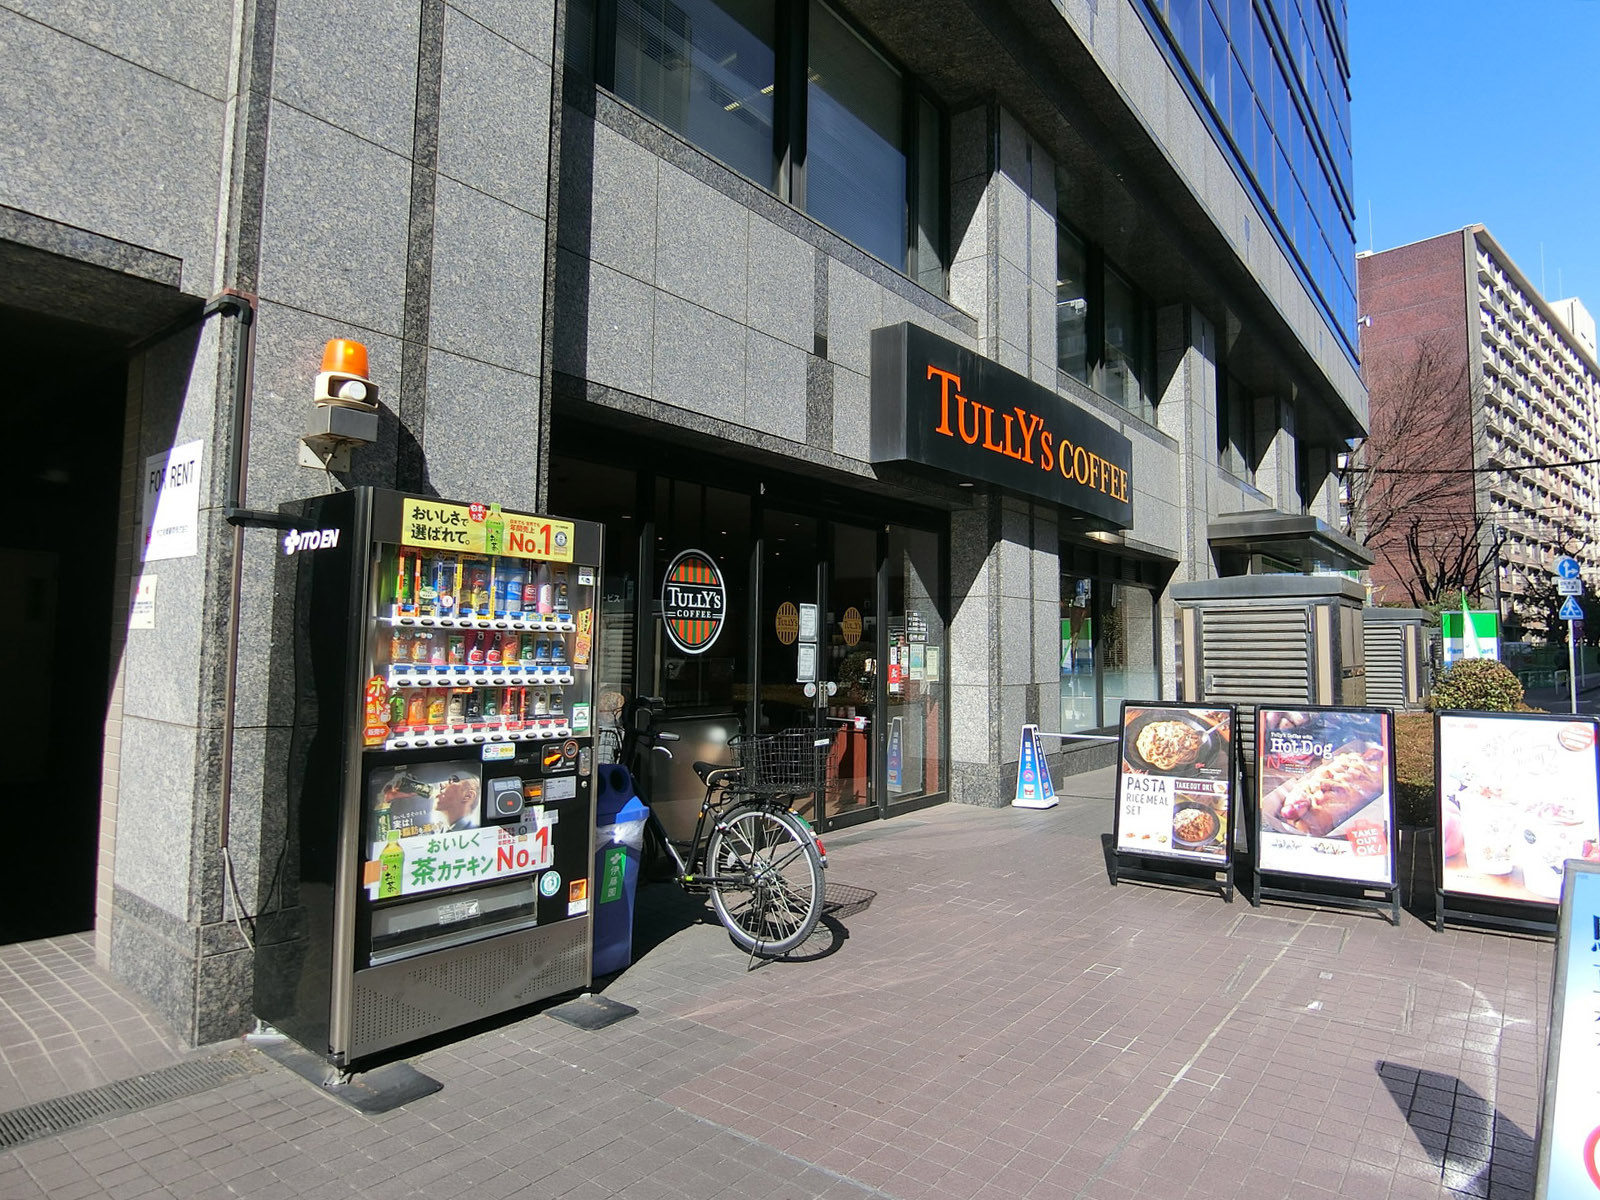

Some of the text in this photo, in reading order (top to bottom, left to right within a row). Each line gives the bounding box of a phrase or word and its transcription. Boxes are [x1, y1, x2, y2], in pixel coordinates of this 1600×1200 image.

[926, 364, 1129, 504] TULLY'S COFFEE
[148, 460, 195, 494] FOR RENT
[411, 506, 468, 527] おいしさで
[410, 523, 470, 545] 選ばれて。
[509, 524, 551, 555] No.1
[667, 587, 722, 609] TULLY'S
[676, 609, 712, 619] COFFEE
[1270, 737, 1333, 760] Hot Dog
[1127, 776, 1166, 793] PASTA
[1125, 804, 1141, 816] SET
[1126, 793, 1169, 806] RICE MEAL
[427, 832, 480, 854] おいしく
[1351, 828, 1379, 839] TAKE
[1356, 836, 1378, 846] OUT
[497, 826, 549, 872] No.1
[1356, 844, 1382, 856] OK!
[411, 855, 494, 886] 茶カテキン
